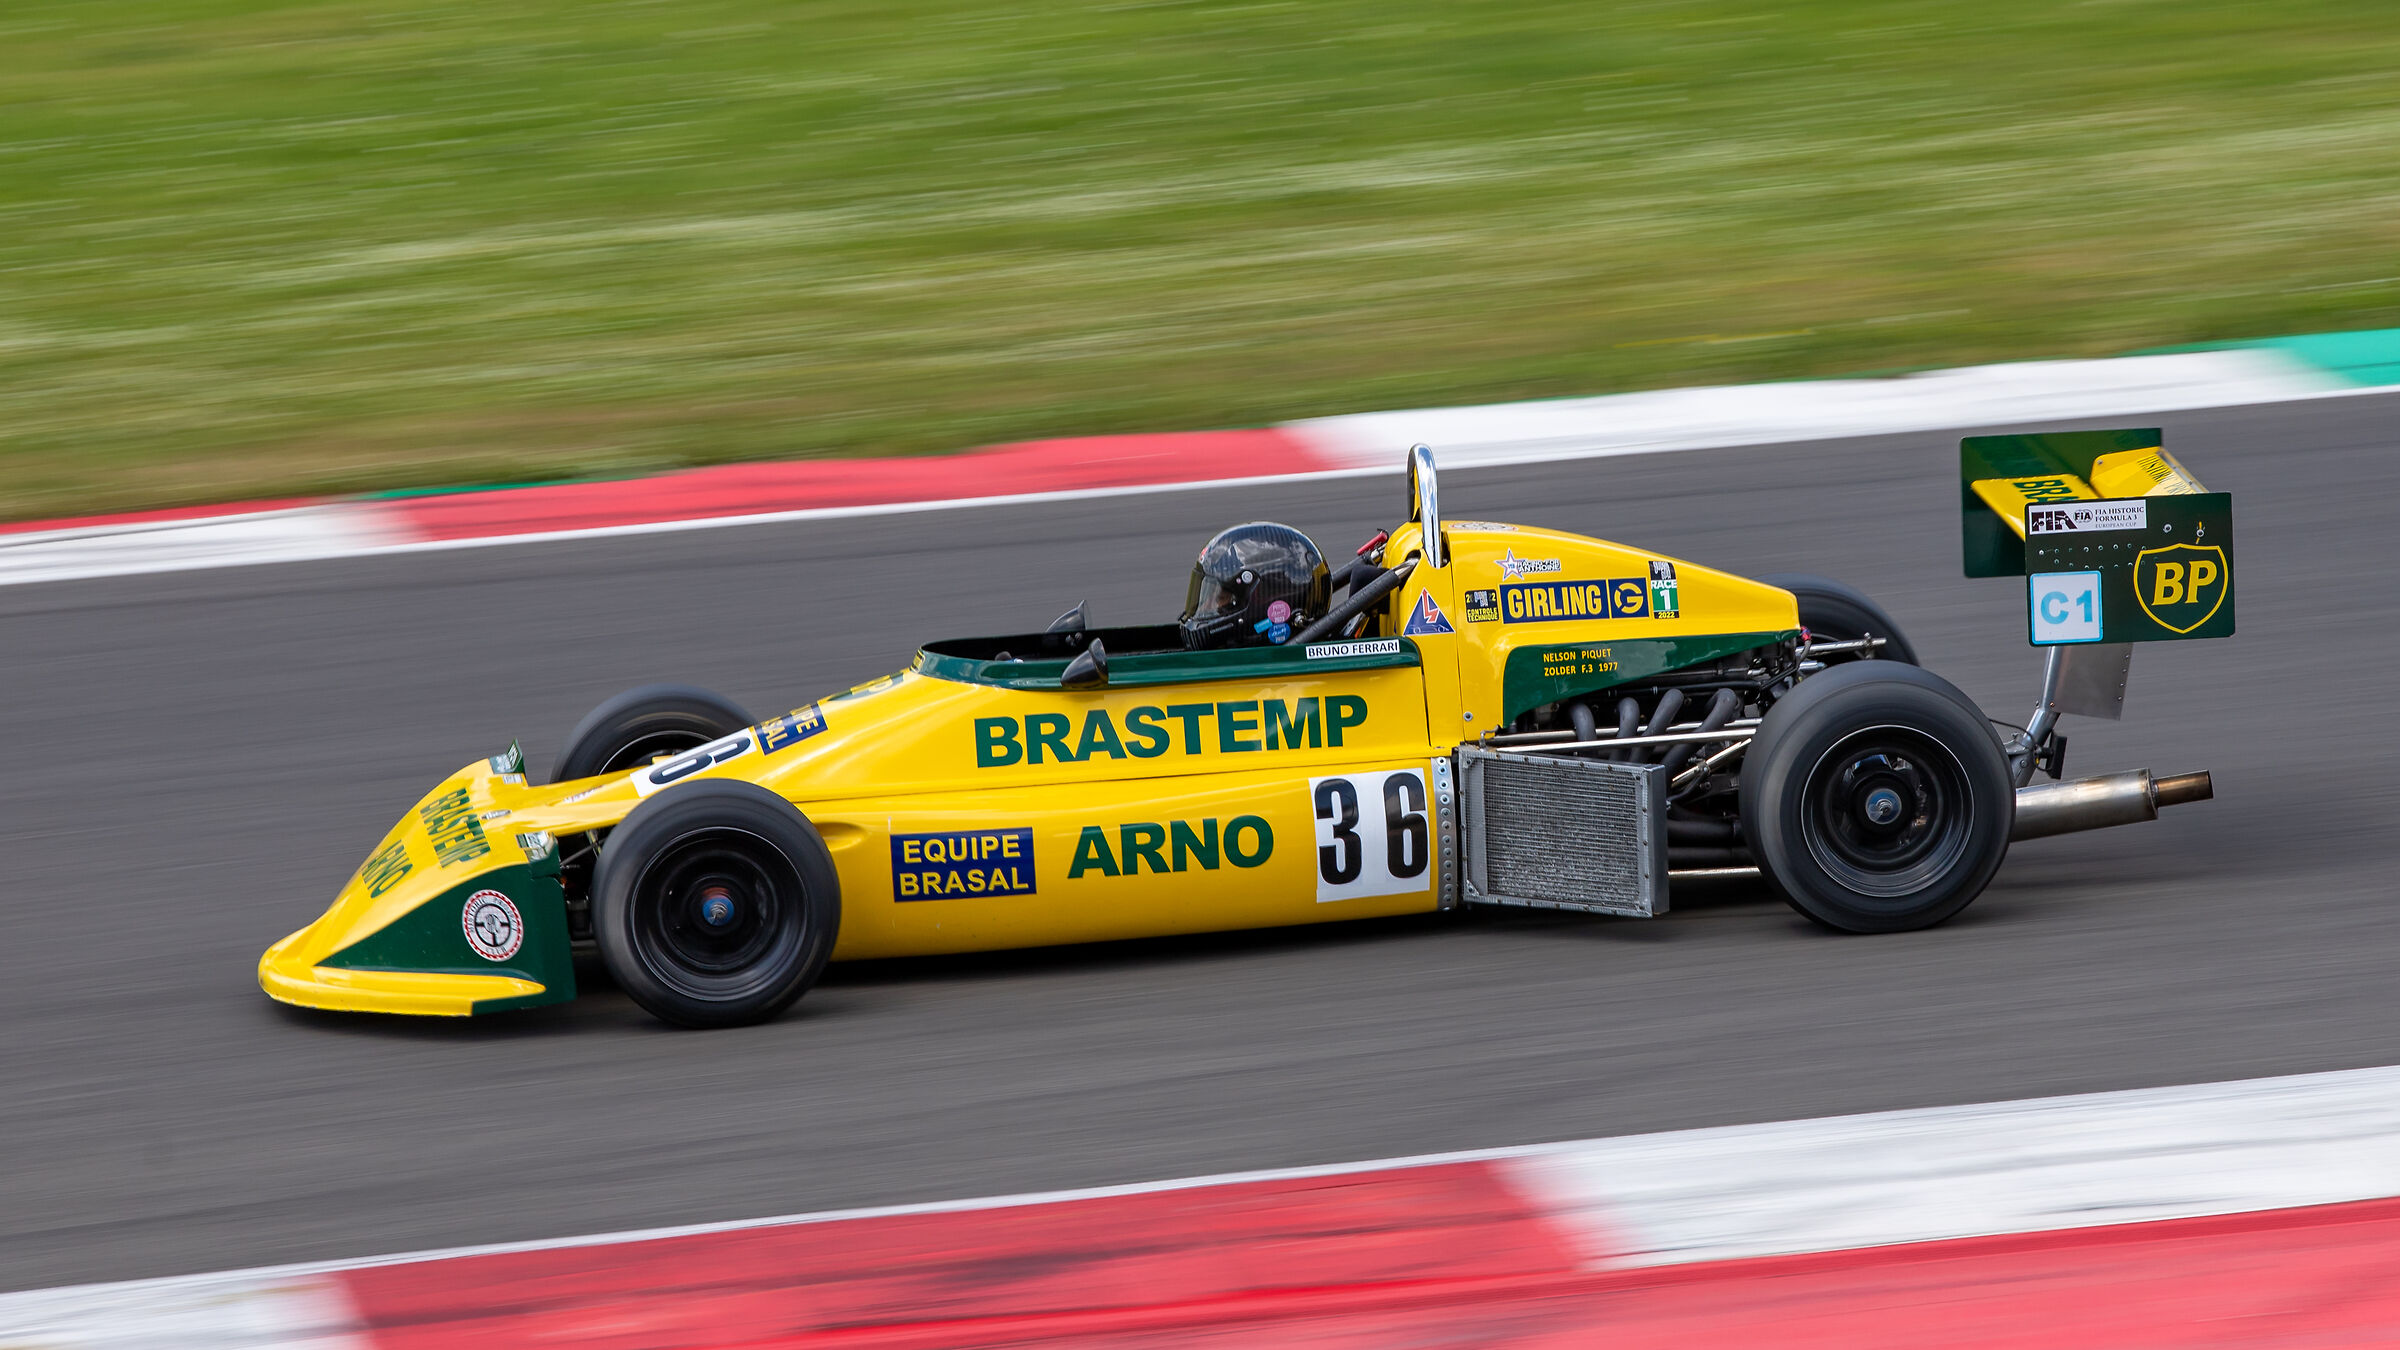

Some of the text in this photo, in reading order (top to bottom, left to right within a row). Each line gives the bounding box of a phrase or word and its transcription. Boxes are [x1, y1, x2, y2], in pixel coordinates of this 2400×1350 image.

[2032, 510, 2078, 532] FIA
[2075, 511, 2092, 521] FIA
[2108, 507, 2144, 515] HISTORIC
[1650, 580, 1678, 590] RACE
[2151, 560, 2218, 606] BP
[1507, 585, 1602, 619] GIRLING
[1659, 589, 1671, 611] 1
[2040, 589, 2094, 625] C1
[1658, 611, 1676, 619] 2022
[1308, 641, 1398, 658] BRUNO FERRARI
[1543, 648, 1612, 663] NELSON PIQUET
[1544, 661, 1618, 677] ZOLDER F.3 1977
[974, 694, 1369, 768] BRASTEMP
[419, 787, 492, 869] BRASTEMP
[1314, 771, 1429, 885] 36
[902, 834, 1022, 864] EQUIPE
[1066, 814, 1275, 879] ARNO
[899, 867, 1029, 897] BRASAL
